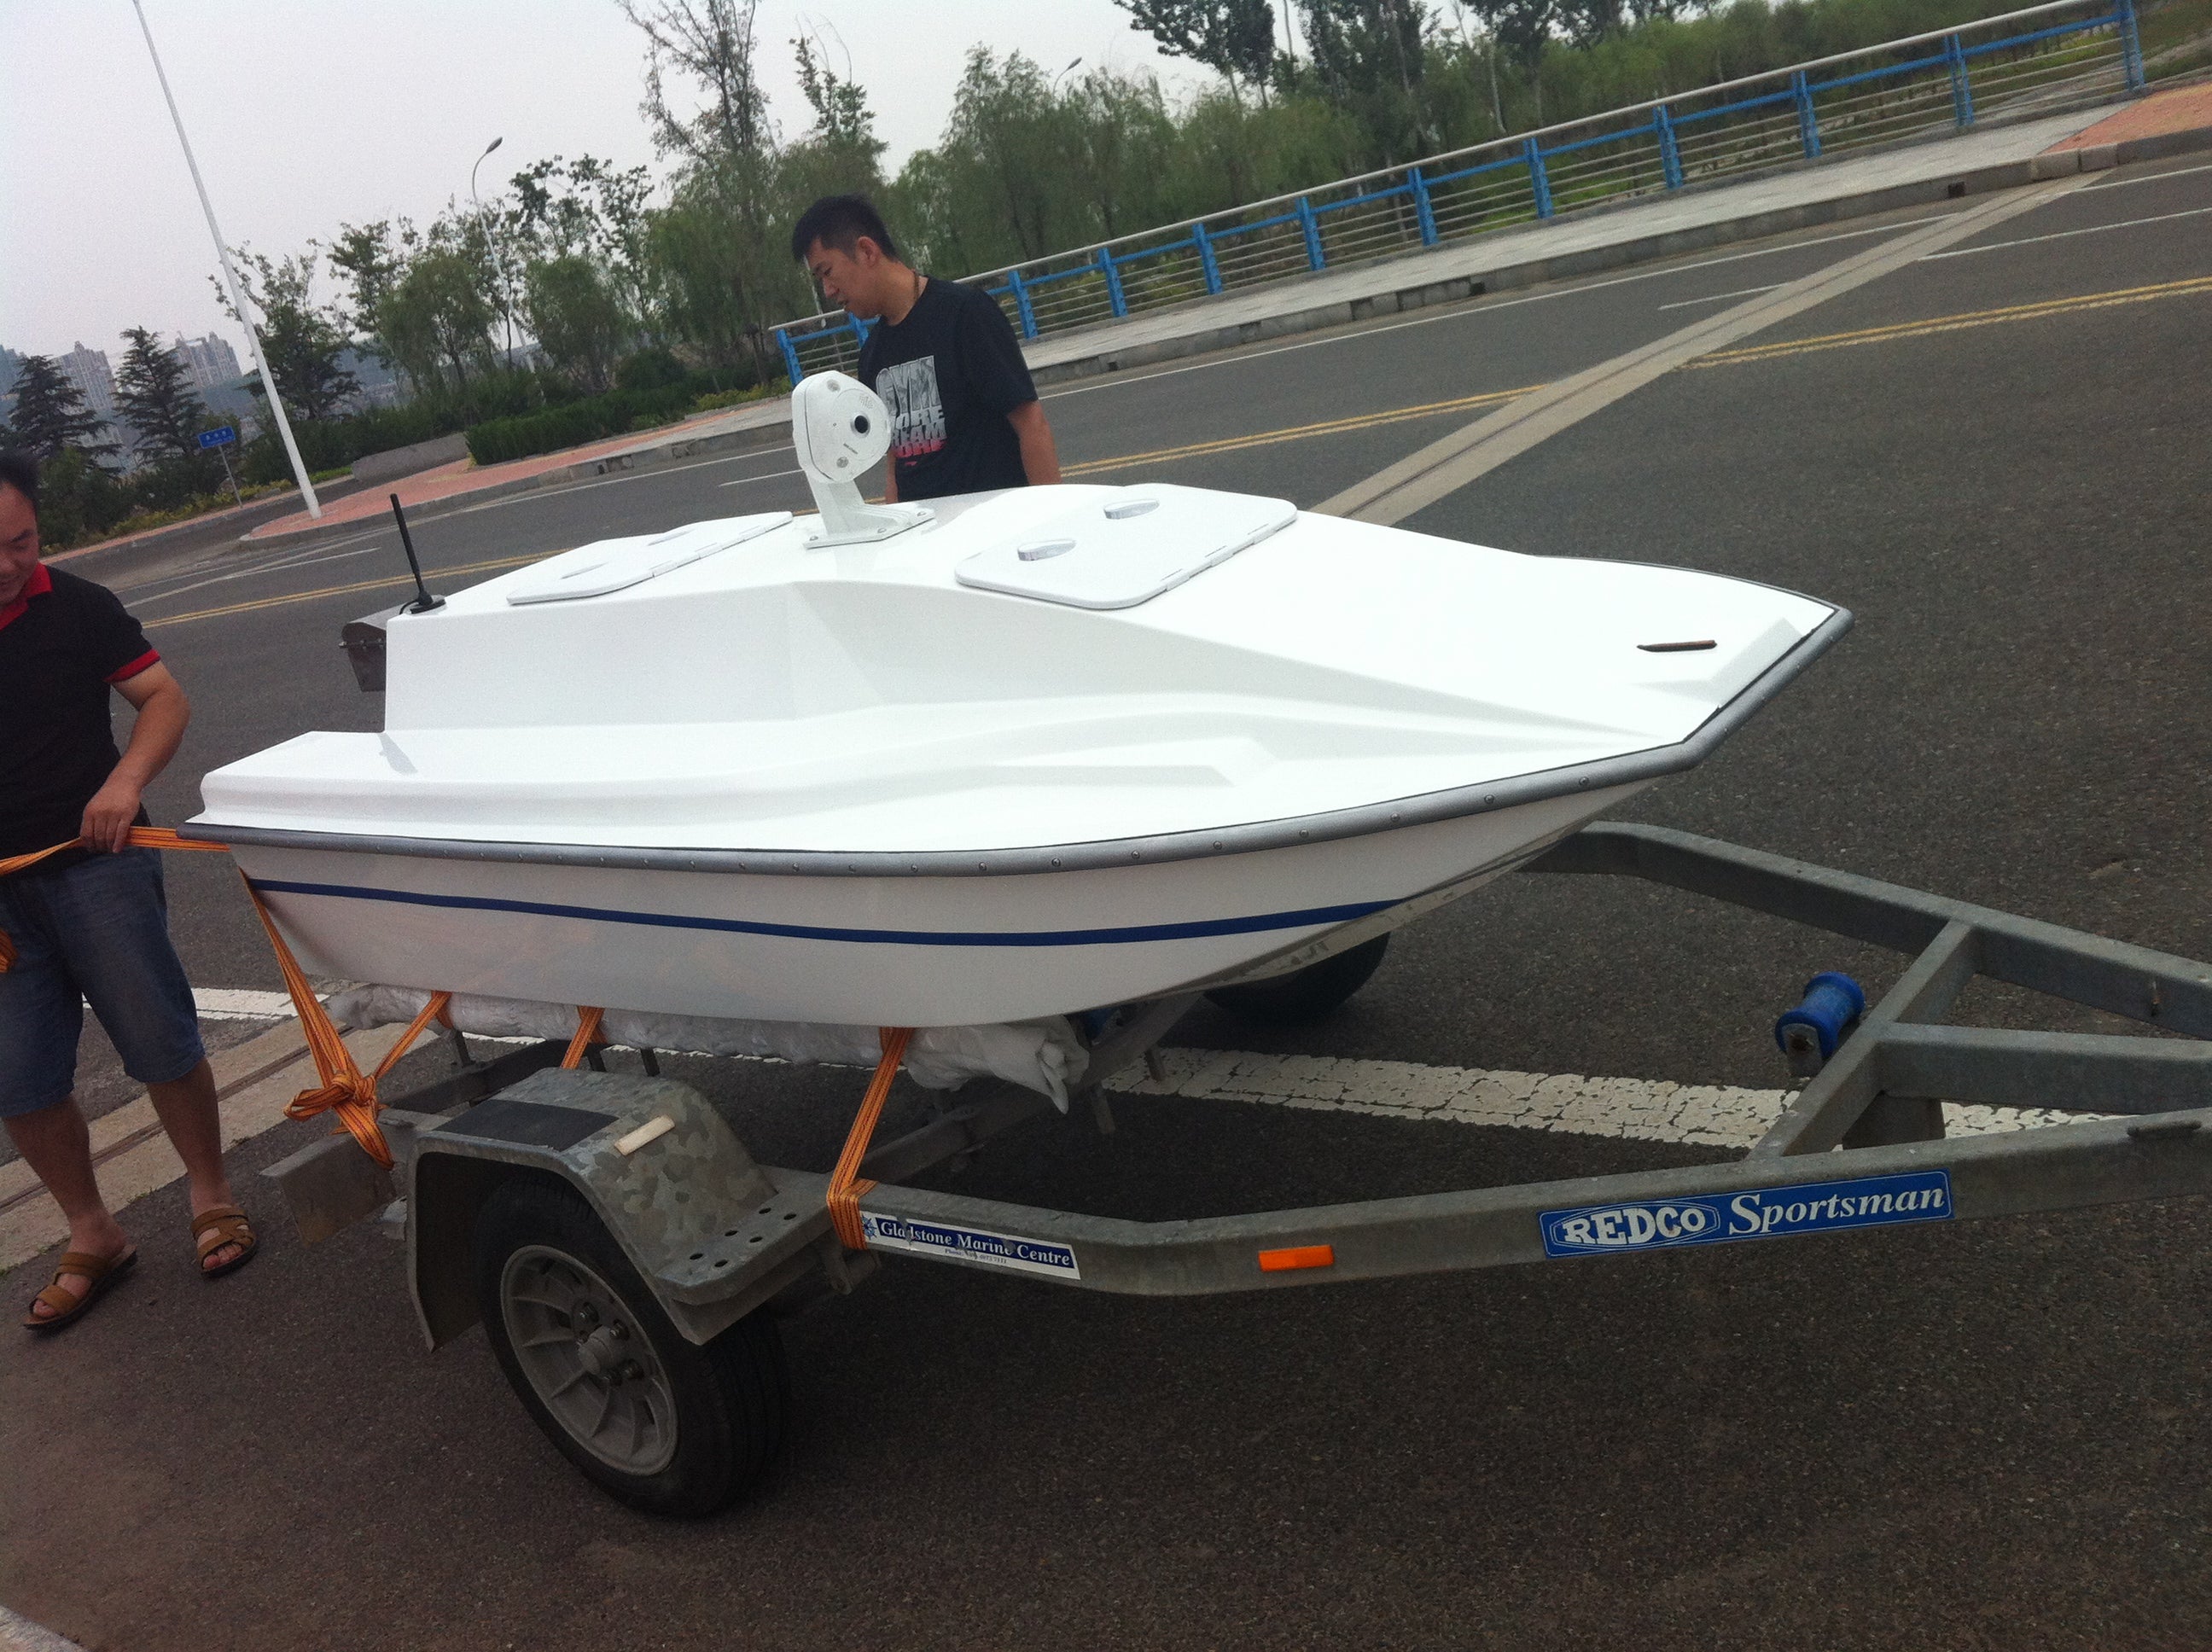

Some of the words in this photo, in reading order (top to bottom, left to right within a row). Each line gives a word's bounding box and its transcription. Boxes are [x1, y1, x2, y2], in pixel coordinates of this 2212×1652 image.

[889, 418, 947, 446] REAM
[1562, 1206, 1707, 1246] REDCO
[1729, 1188, 1946, 1234] Sportsman
[1017, 1244, 1070, 1265] Centre
